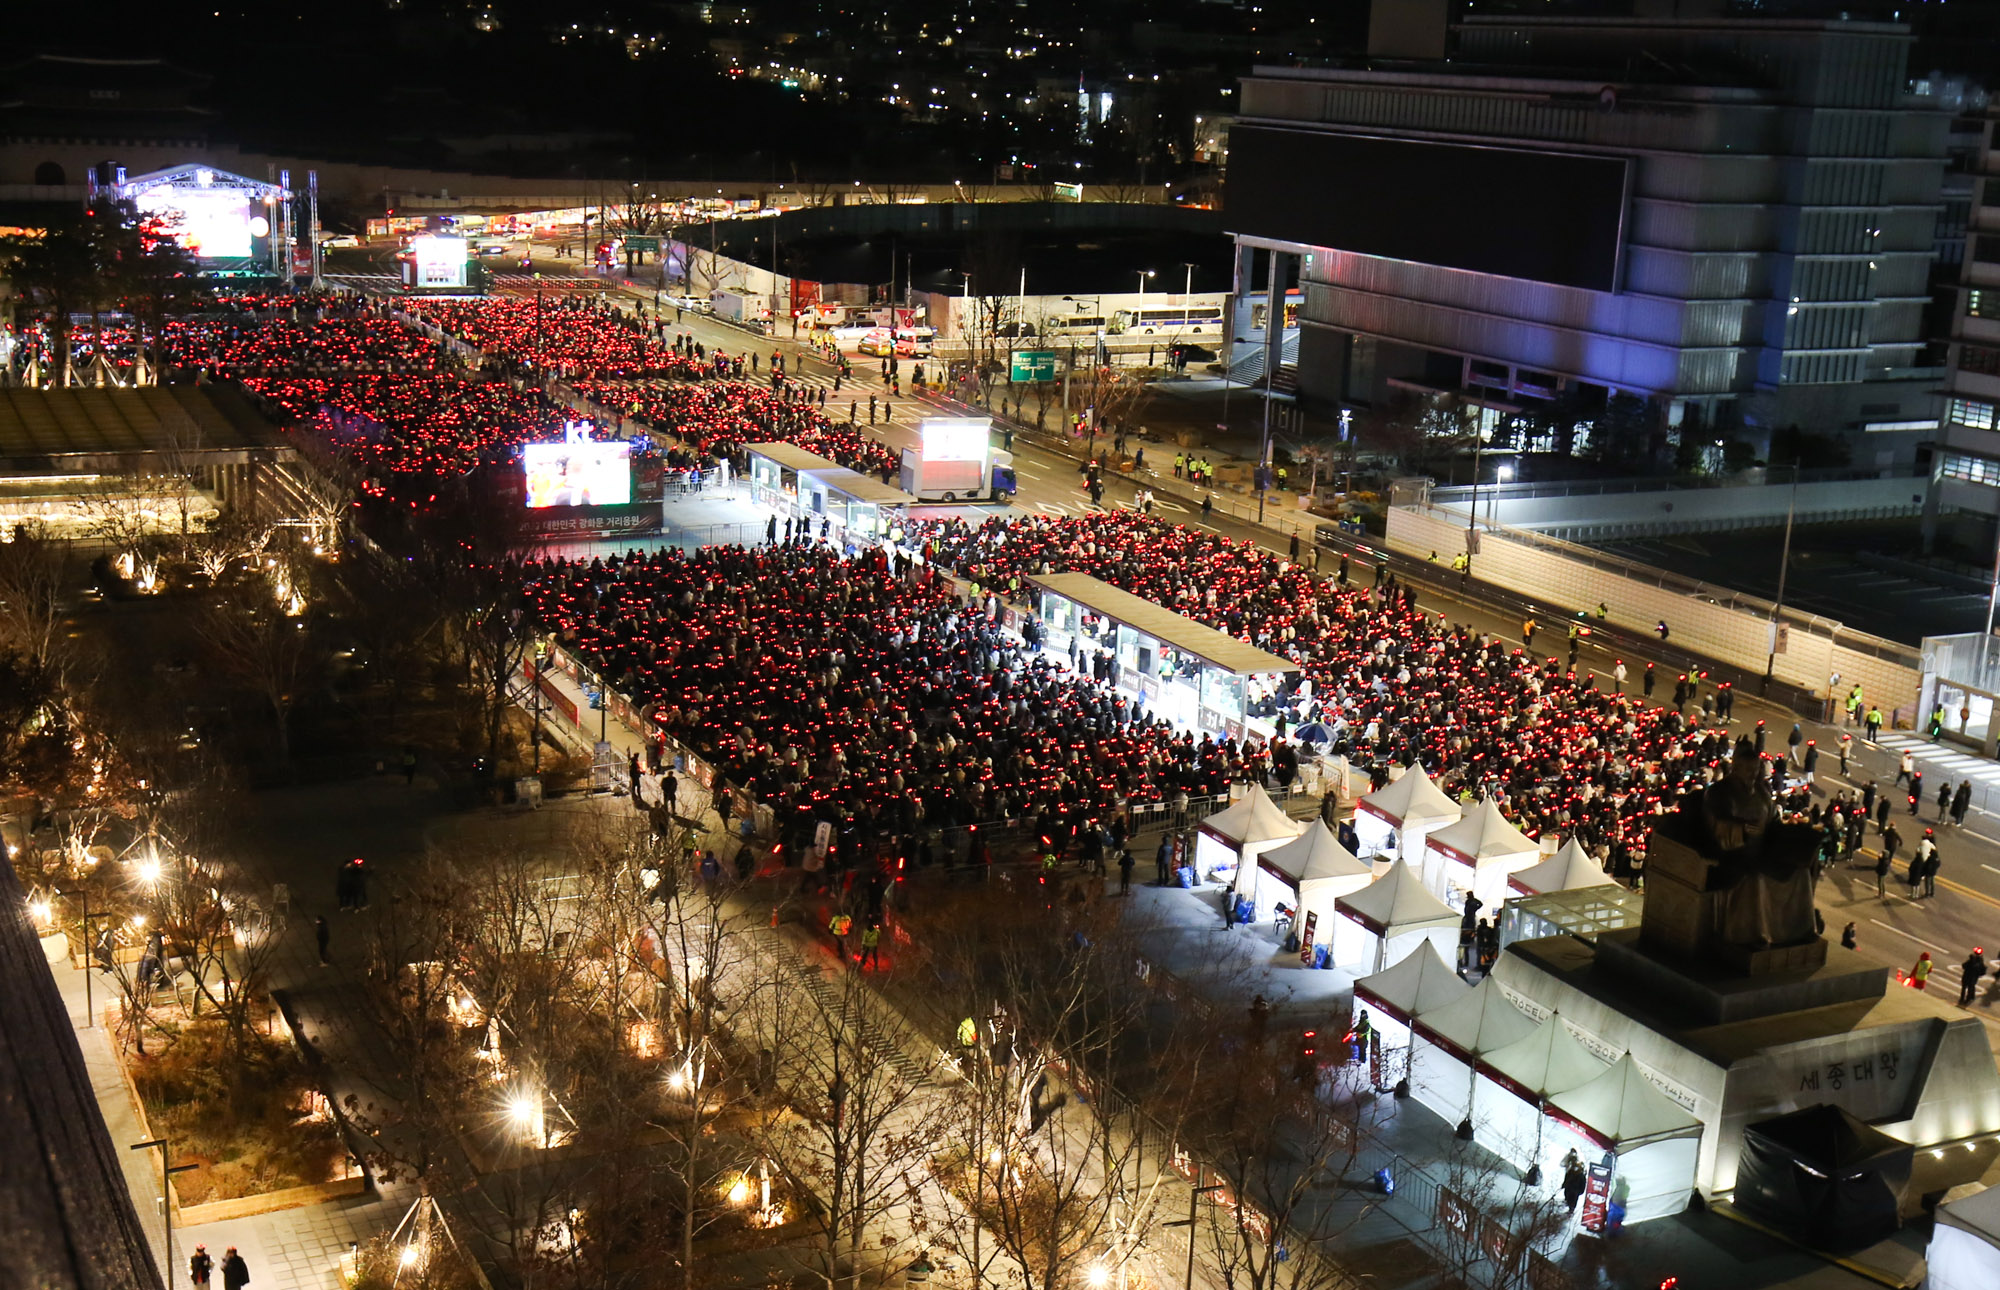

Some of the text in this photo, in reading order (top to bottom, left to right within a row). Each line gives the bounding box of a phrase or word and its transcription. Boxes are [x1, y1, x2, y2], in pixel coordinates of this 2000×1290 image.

[566, 421, 594, 443] kt
[543, 519, 577, 531] 대한민국
[579, 517, 604, 529] 광화문
[606, 515, 640, 527] 거리응원
[688, 754, 697, 776] kt
[1800, 1051, 1900, 1092] 세종대왕
